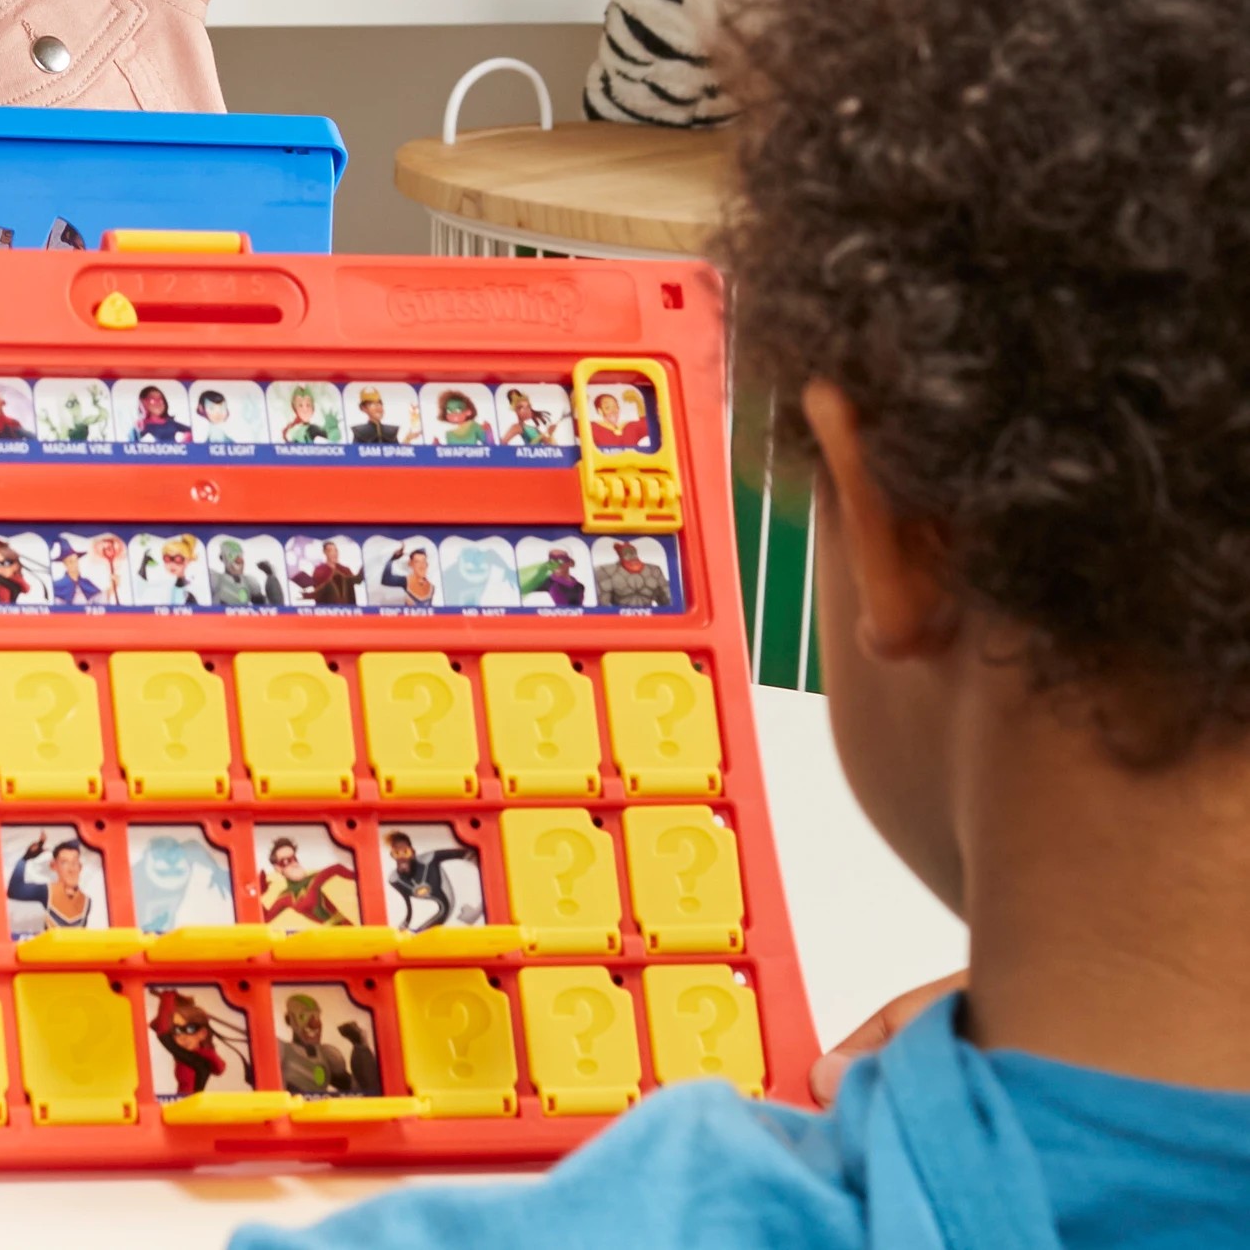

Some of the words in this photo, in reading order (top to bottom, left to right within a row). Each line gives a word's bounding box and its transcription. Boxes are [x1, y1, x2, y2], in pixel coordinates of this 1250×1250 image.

[42, 443, 88, 454] MADAME
[90, 444, 113, 455] VINE
[123, 444, 187, 455] ULTRASONIC
[209, 445, 224, 456] ICE
[225, 445, 256, 456] LIGHT
[274, 445, 345, 457] THUNDERSHOCK
[358, 446, 381, 457] SAM
[382, 446, 416, 458] SPARK
[436, 446, 490, 458] SWAPSHIFT
[516, 447, 563, 459] ATLANTIA
